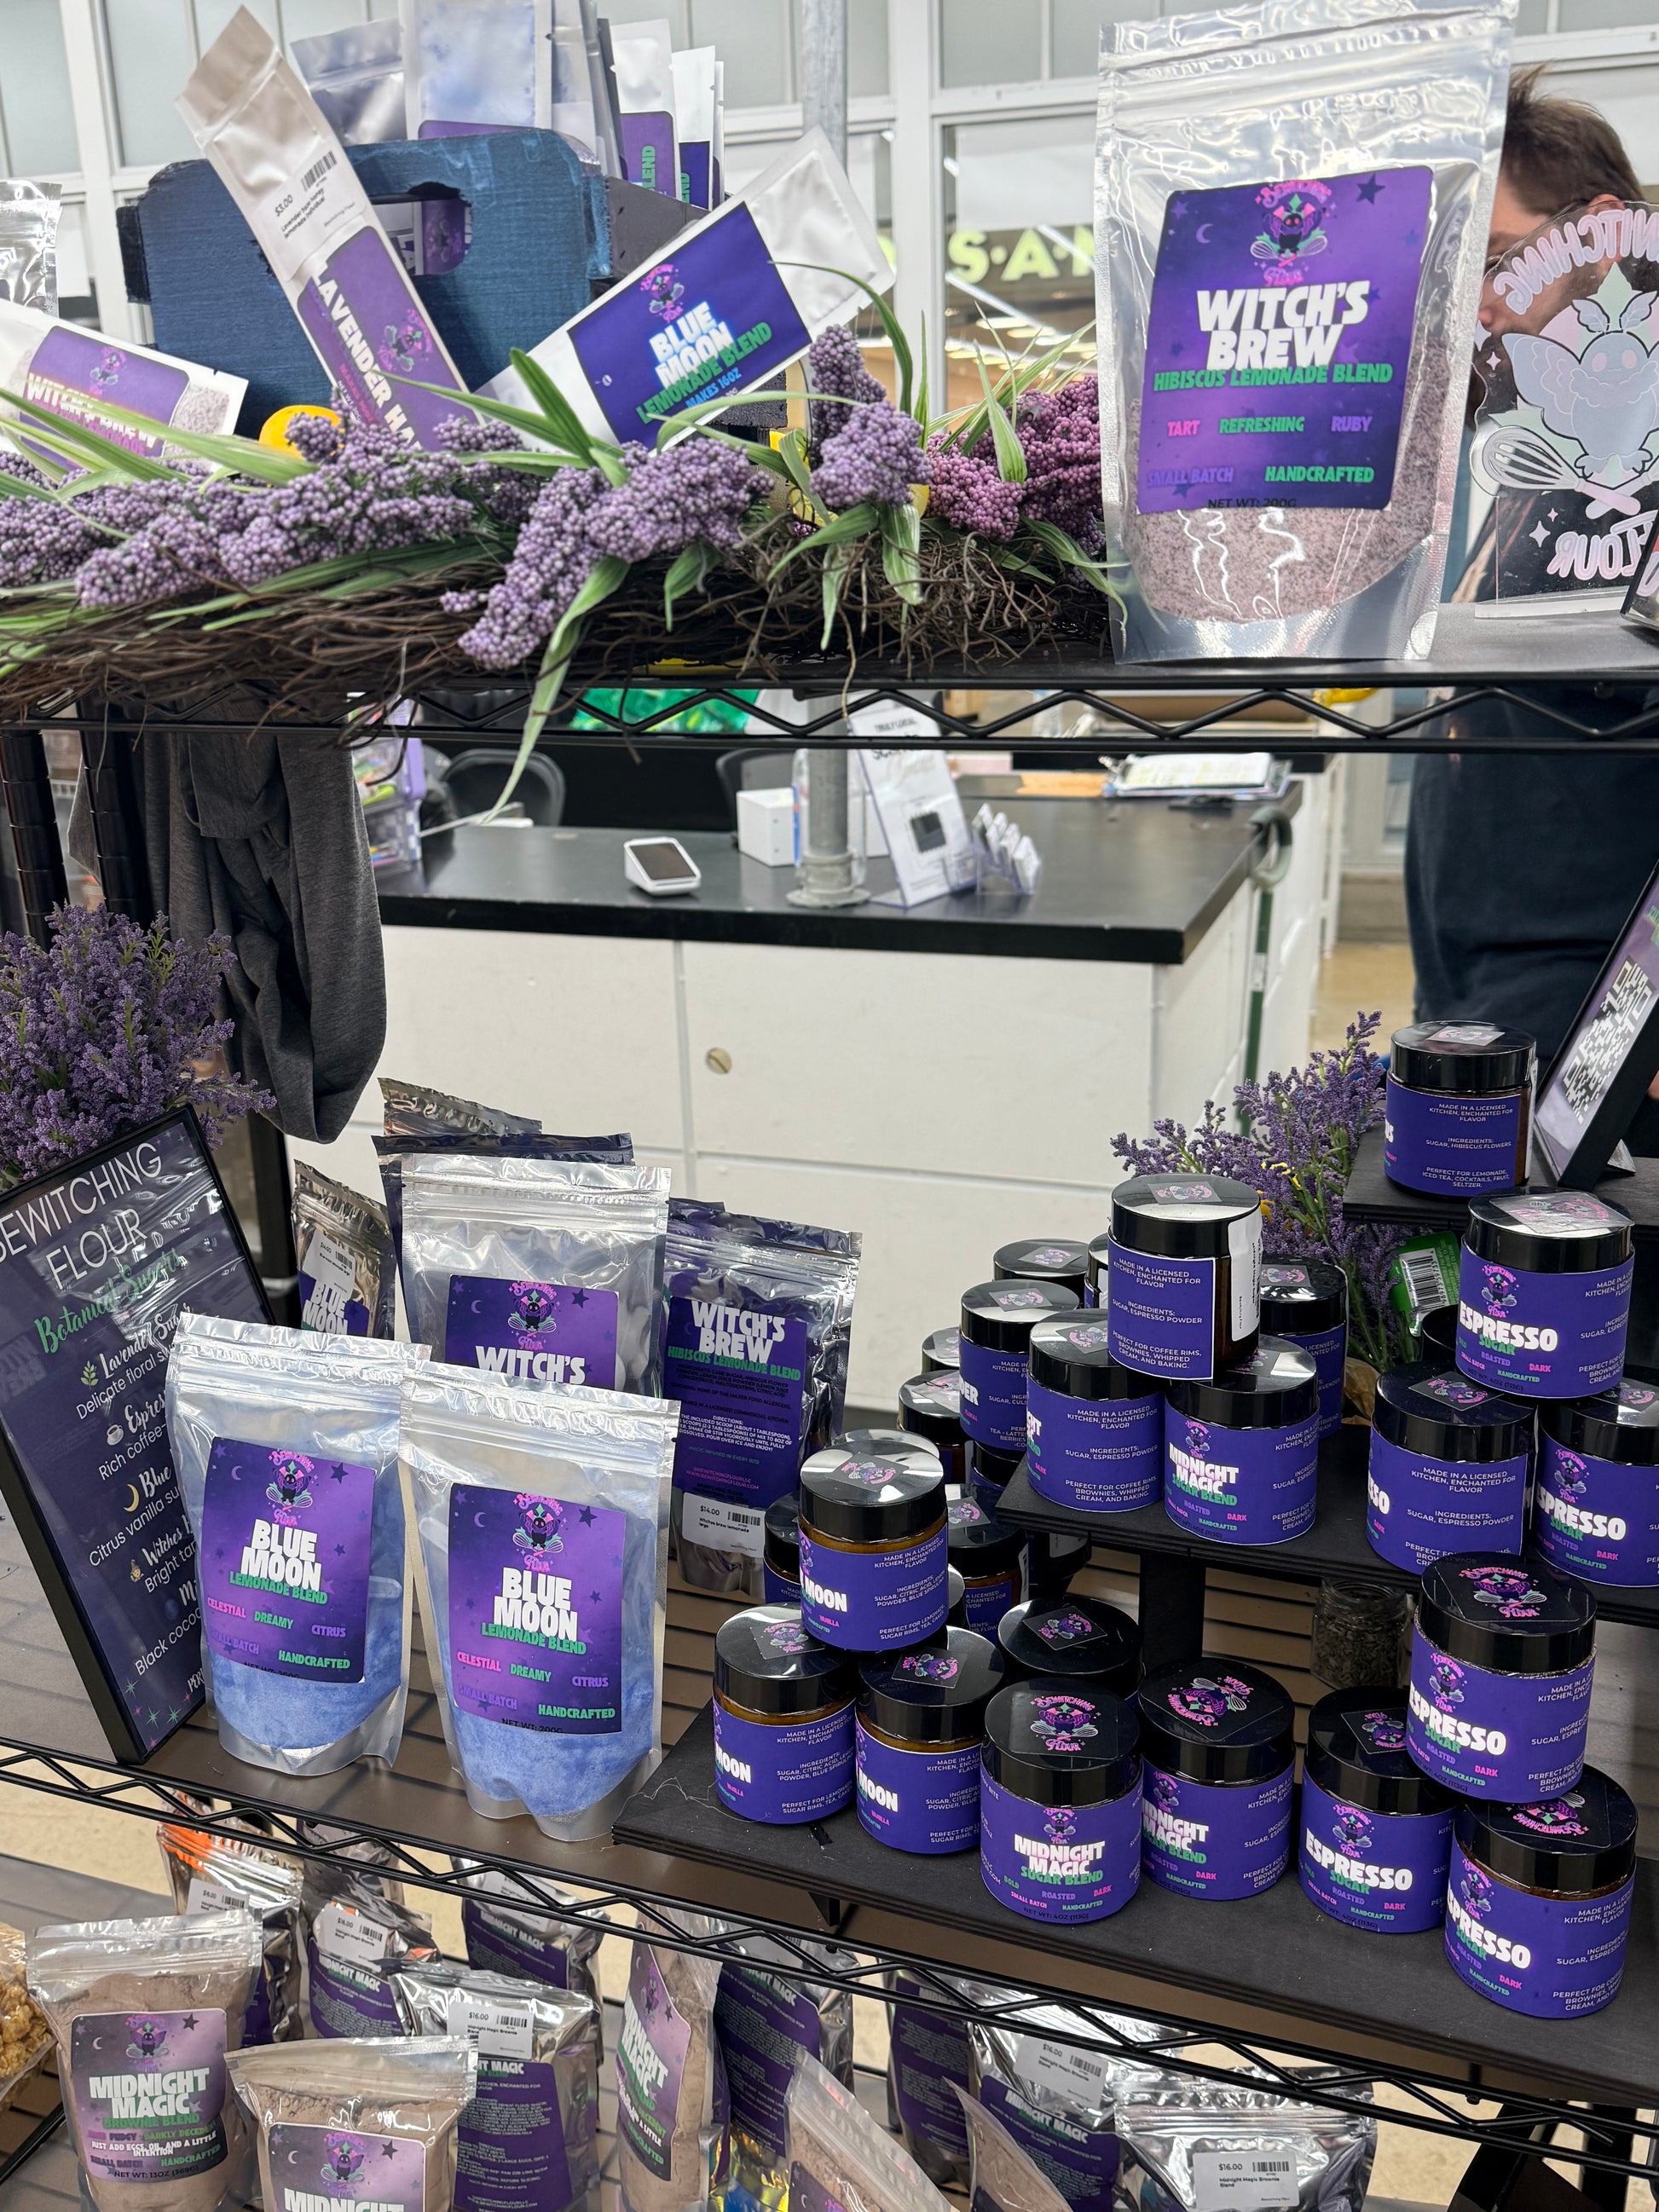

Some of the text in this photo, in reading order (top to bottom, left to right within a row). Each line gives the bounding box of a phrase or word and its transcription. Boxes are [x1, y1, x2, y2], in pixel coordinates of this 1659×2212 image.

[275, 194, 292, 217] $3.00
[1196, 280, 1371, 332] WITCH'S
[312, 260, 392, 408] LAVENDER
[649, 301, 716, 364] BLUE
[655, 321, 735, 390] MOON
[1206, 324, 1344, 371] BREW
[635, 321, 772, 424] LEMONADE BLEND
[1153, 363, 1393, 391] HIBISCUS LEMONADE BLEND
[685, 384, 720, 409] MAKES
[1167, 416, 1373, 437] TART REFRESHING RUBY
[1147, 466, 1375, 487] SMALL BATCH HANDCRAFTED
[1208, 498, 1297, 508] NET WT: 200G
[45, 1208, 147, 1291] FLOUR
[1113, 1262, 1136, 1276] KITCHEN,
[1137, 1272, 1182, 1284] ENCHANTED
[1119, 1258, 1136, 1269] MADE
[1152, 1268, 1189, 1277] LICENSED
[1136, 1279, 1165, 1289] FLAVOR
[33, 1279, 122, 1354] Botanical
[118, 1246, 183, 1303] Sugars
[311, 1280, 349, 1319] BLUE
[1128, 1301, 1176, 1316] INGREDIENTS:
[303, 1299, 348, 1335] MOON
[691, 1300, 786, 1343] WITCH'S
[1130, 1308, 1165, 1321] ESPRESSO
[1460, 1300, 1558, 1352] ESPRESSO
[698, 1326, 774, 1364] BREW
[1113, 1330, 1133, 1345] PERFECT
[1149, 1346, 1178, 1355] COFFEE
[1118, 1341, 1190, 1362] BROWNIES, WHIPPED
[1119, 1347, 1139, 1361] CREAM,
[1478, 1334, 1516, 1356] SUGAR
[475, 1345, 586, 1384] WITCH'S
[668, 1346, 801, 1381] HIBISCUS LEMONADE BLEND
[1481, 1351, 1551, 1372] ROASTED DARK
[76, 1378, 126, 1420] Delicate
[126, 1354, 157, 1384] floral
[1497, 1369, 1540, 1383] HANDCRAFTED
[713, 1415, 743, 1425] DIRECTIONS:
[98, 1453, 127, 1481] Rich
[1169, 1442, 1240, 1484] MIDNIGHT
[138, 1464, 171, 1498] Blue
[1176, 1464, 1224, 1495] MAGIC
[1201, 1488, 1238, 1506] BLEND
[700, 1505, 720, 1516] $14.00
[1227, 1513, 1247, 1522] DARK
[1434, 1510, 1493, 1520] INGREDIENTS:
[1438, 1515, 1514, 1528] ESPRESSO POWDER
[89, 1531, 126, 1568] Citrus
[126, 1500, 165, 1538] vanilla
[251, 1519, 318, 1562] BLUE
[727, 1524, 749, 1533] lemonade
[1550, 1519, 1584, 1542] SUGAR
[142, 1526, 183, 1568] Witches
[1596, 1551, 1619, 1561] DARK
[145, 1551, 180, 1594] Bright
[240, 1546, 322, 1592] MOON
[228, 1571, 328, 1605] LEMONADE BLEND
[501, 1567, 572, 1611] BLUE
[806, 1580, 847, 1613] MOON
[207, 1597, 346, 1637] CELESTIAL DREAMY CITRUS
[494, 1596, 578, 1642] MOON
[481, 1622, 587, 1655] LEMONADE BLEND
[135, 1641, 169, 1677] Black
[278, 1650, 350, 1669] HANDCRAFTED
[456, 1651, 609, 1688] CELESTIAL DREAMY CITRUS
[487, 1693, 616, 1719] BATCH HANDCRAFTED
[1410, 1680, 1506, 1756] ESPRESSO
[1425, 1724, 1461, 1754] SUGAR
[1442, 1764, 1486, 1787] HANDCRAFTED
[1475, 1764, 1498, 1777] DARK
[858, 1769, 899, 1813] MOON
[1142, 1799, 1209, 1843] IDNIGHT
[1014, 1834, 1106, 1861] MIDNIGHT
[1305, 1828, 1413, 1891] ESPRESSO
[1020, 1865, 1104, 1886] SUGAR BLEND
[1028, 1856, 1090, 1877] MAGIC
[1196, 1870, 1217, 1880] DARK
[1042, 1885, 1113, 1900] ROASTED DARK
[1329, 1868, 1370, 1895] SUGAR
[1061, 1900, 1103, 1911] HANDCRAFTED
[1332, 1886, 1406, 1910] ROASTED DARK
[1350, 1906, 1395, 1920] HANDCRAFTED
[1499, 1974, 1523, 1990] DARK
[1043, 2043, 1062, 2057] $16.00
[491, 2060, 524, 2075] MAGIC
[89, 2067, 210, 2099] MIDNIGHT
[112, 2092, 190, 2119] MAGIC
[103, 2113, 200, 2128] BROWNIE BLEND
[1053, 2118, 1089, 2144] MAGIC
[92, 2141, 107, 2150] JUST
[166, 2140, 182, 2149] AND
[192, 2130, 217, 2145] LITTLE
[133, 2147, 173, 2157] INTENTION
[161, 2144, 221, 2167] HANDCRAFTED
